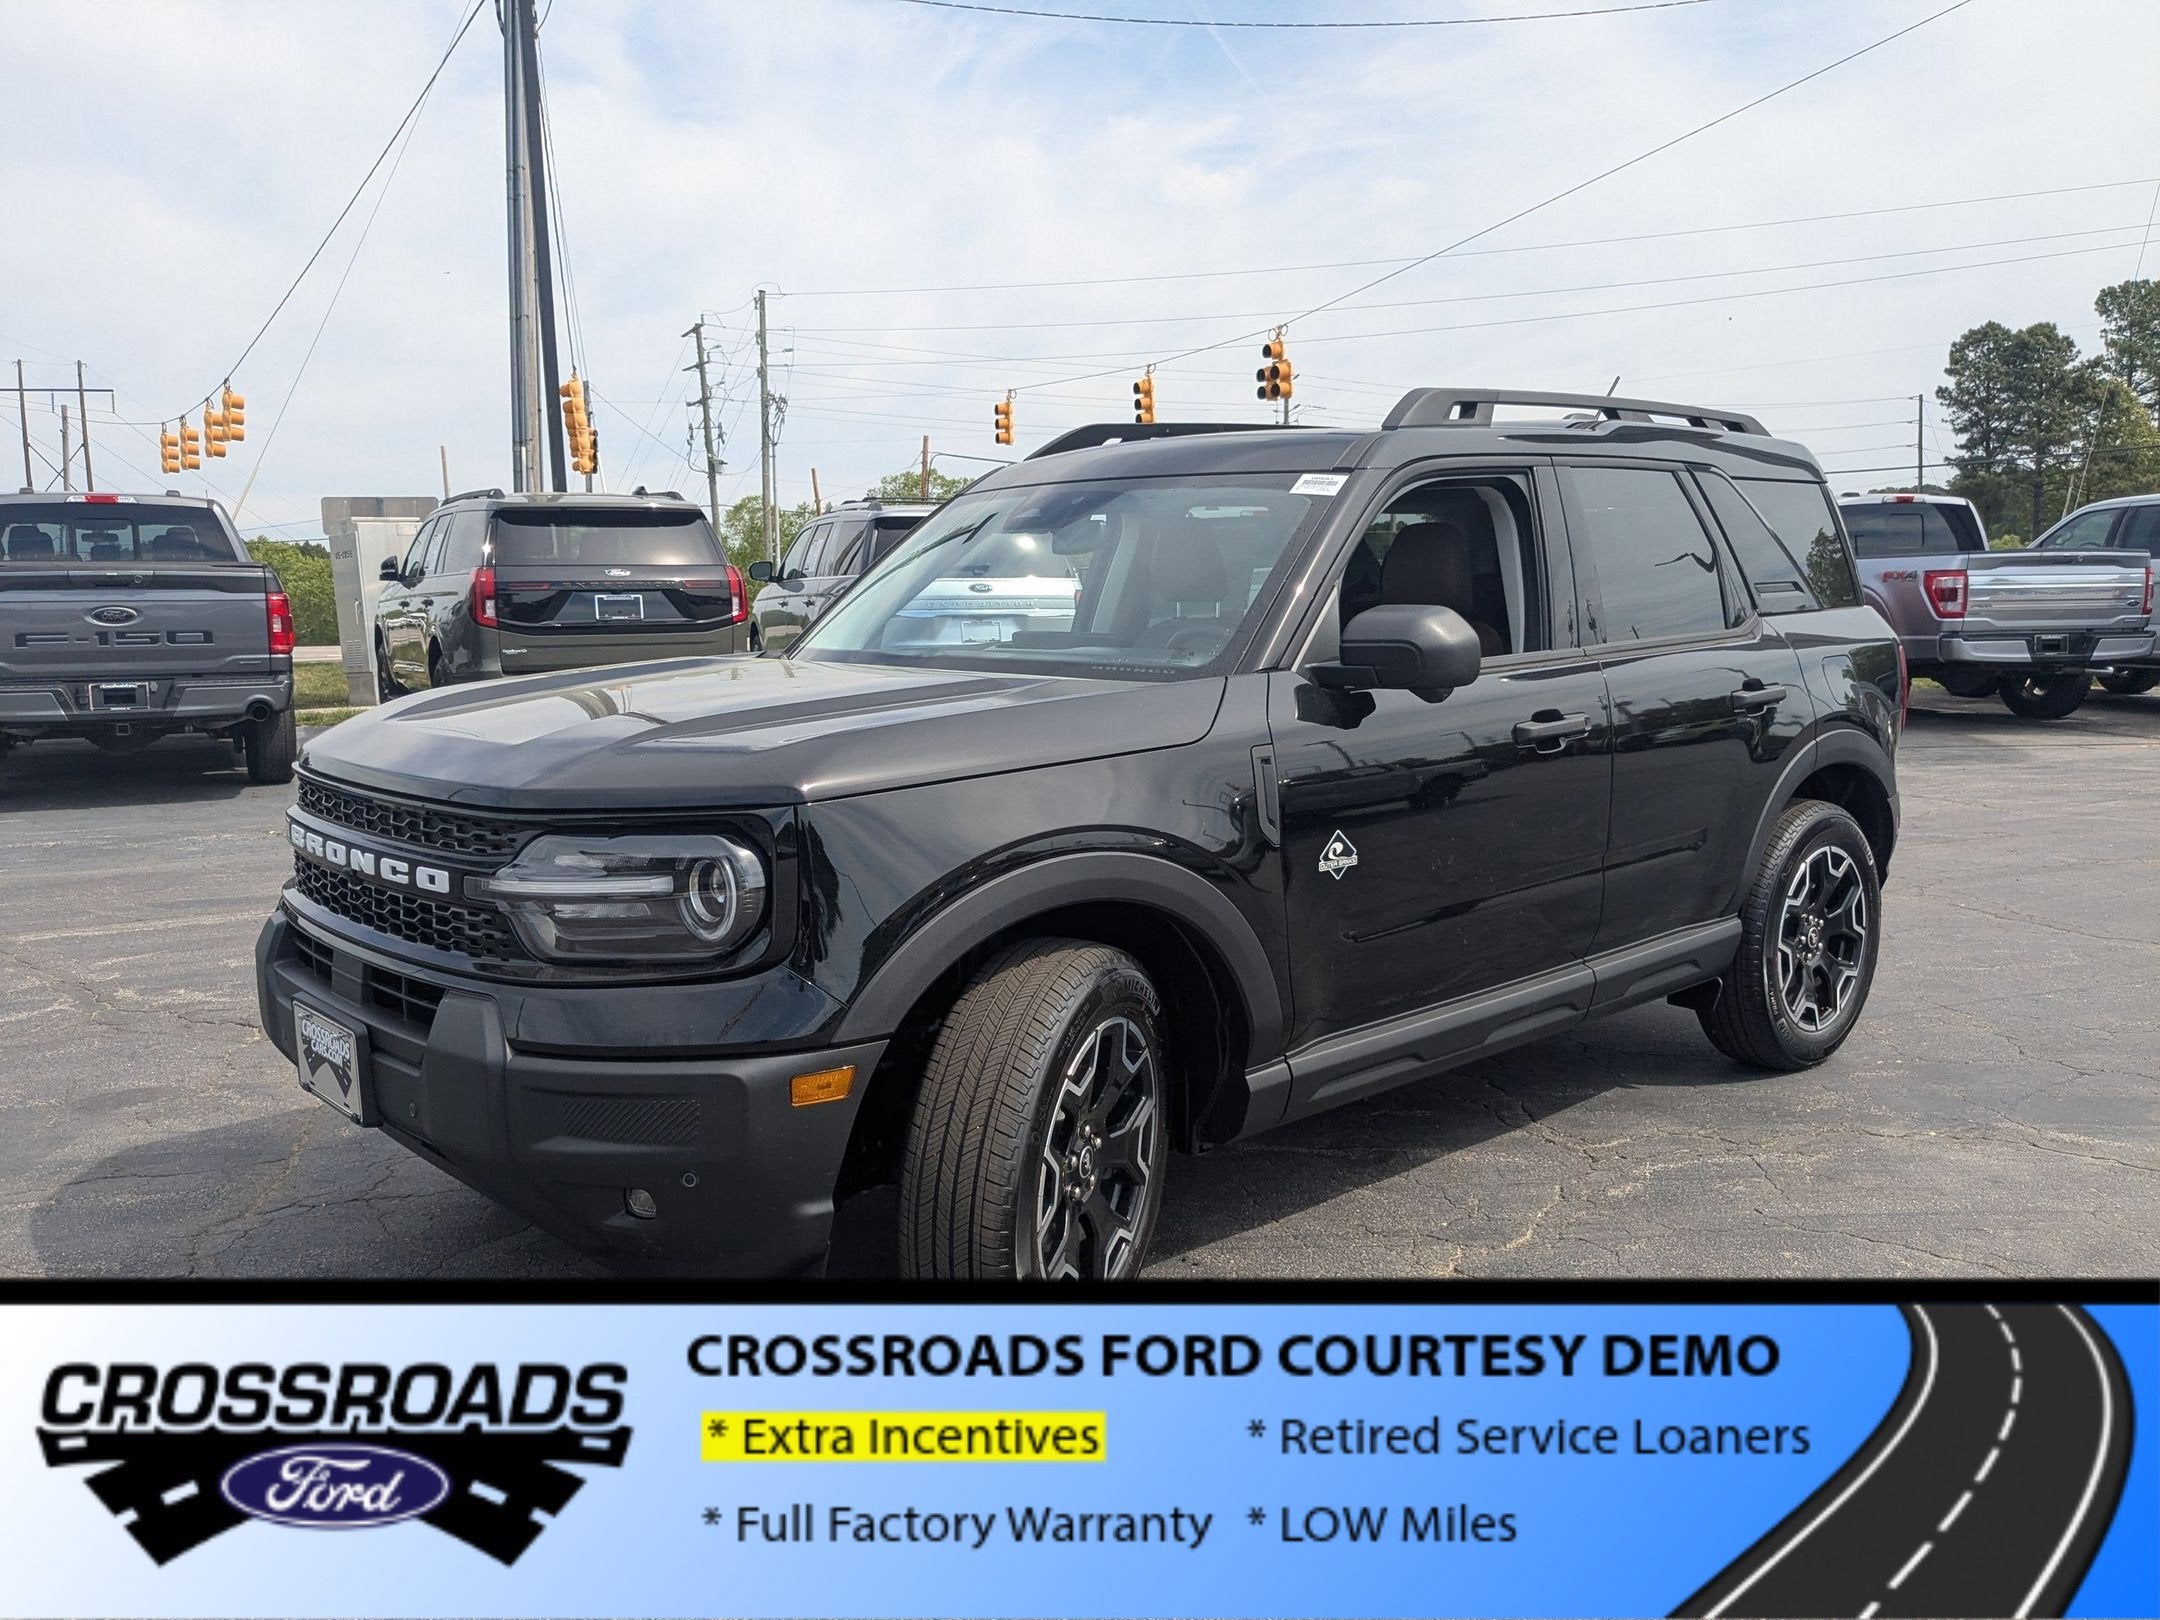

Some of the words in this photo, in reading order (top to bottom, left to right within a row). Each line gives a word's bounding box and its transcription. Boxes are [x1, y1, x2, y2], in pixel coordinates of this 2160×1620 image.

[1882, 570, 1917, 582] FX4
[101, 609, 127, 622] Ford
[14, 630, 214, 649] F-150
[290, 823, 450, 894] BRONCO
[301, 1018, 350, 1061] CROSSROADS
